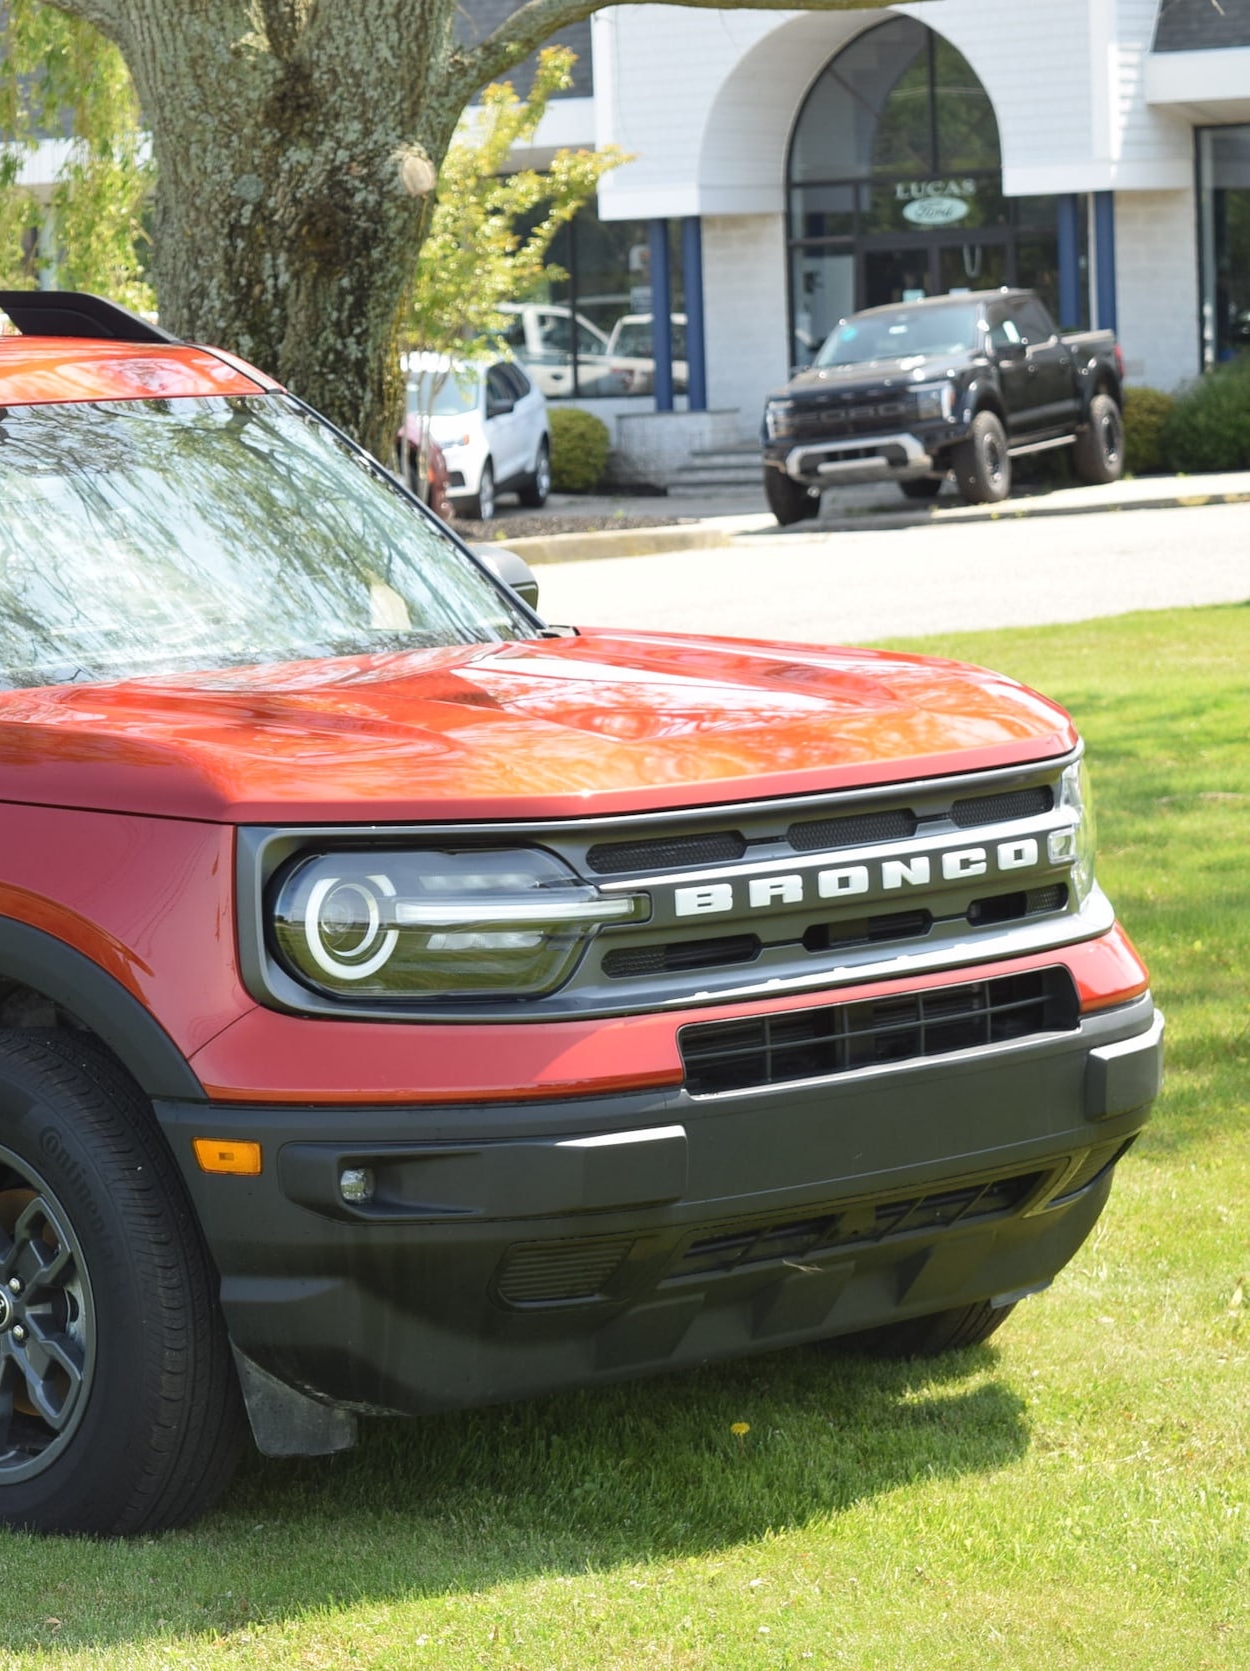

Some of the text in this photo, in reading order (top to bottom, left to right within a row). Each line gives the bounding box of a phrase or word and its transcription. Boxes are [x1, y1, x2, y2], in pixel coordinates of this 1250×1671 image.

[896, 178, 976, 200] LUCAS
[795, 403, 905, 422] FORD
[674, 838, 1038, 917] BRONCO
